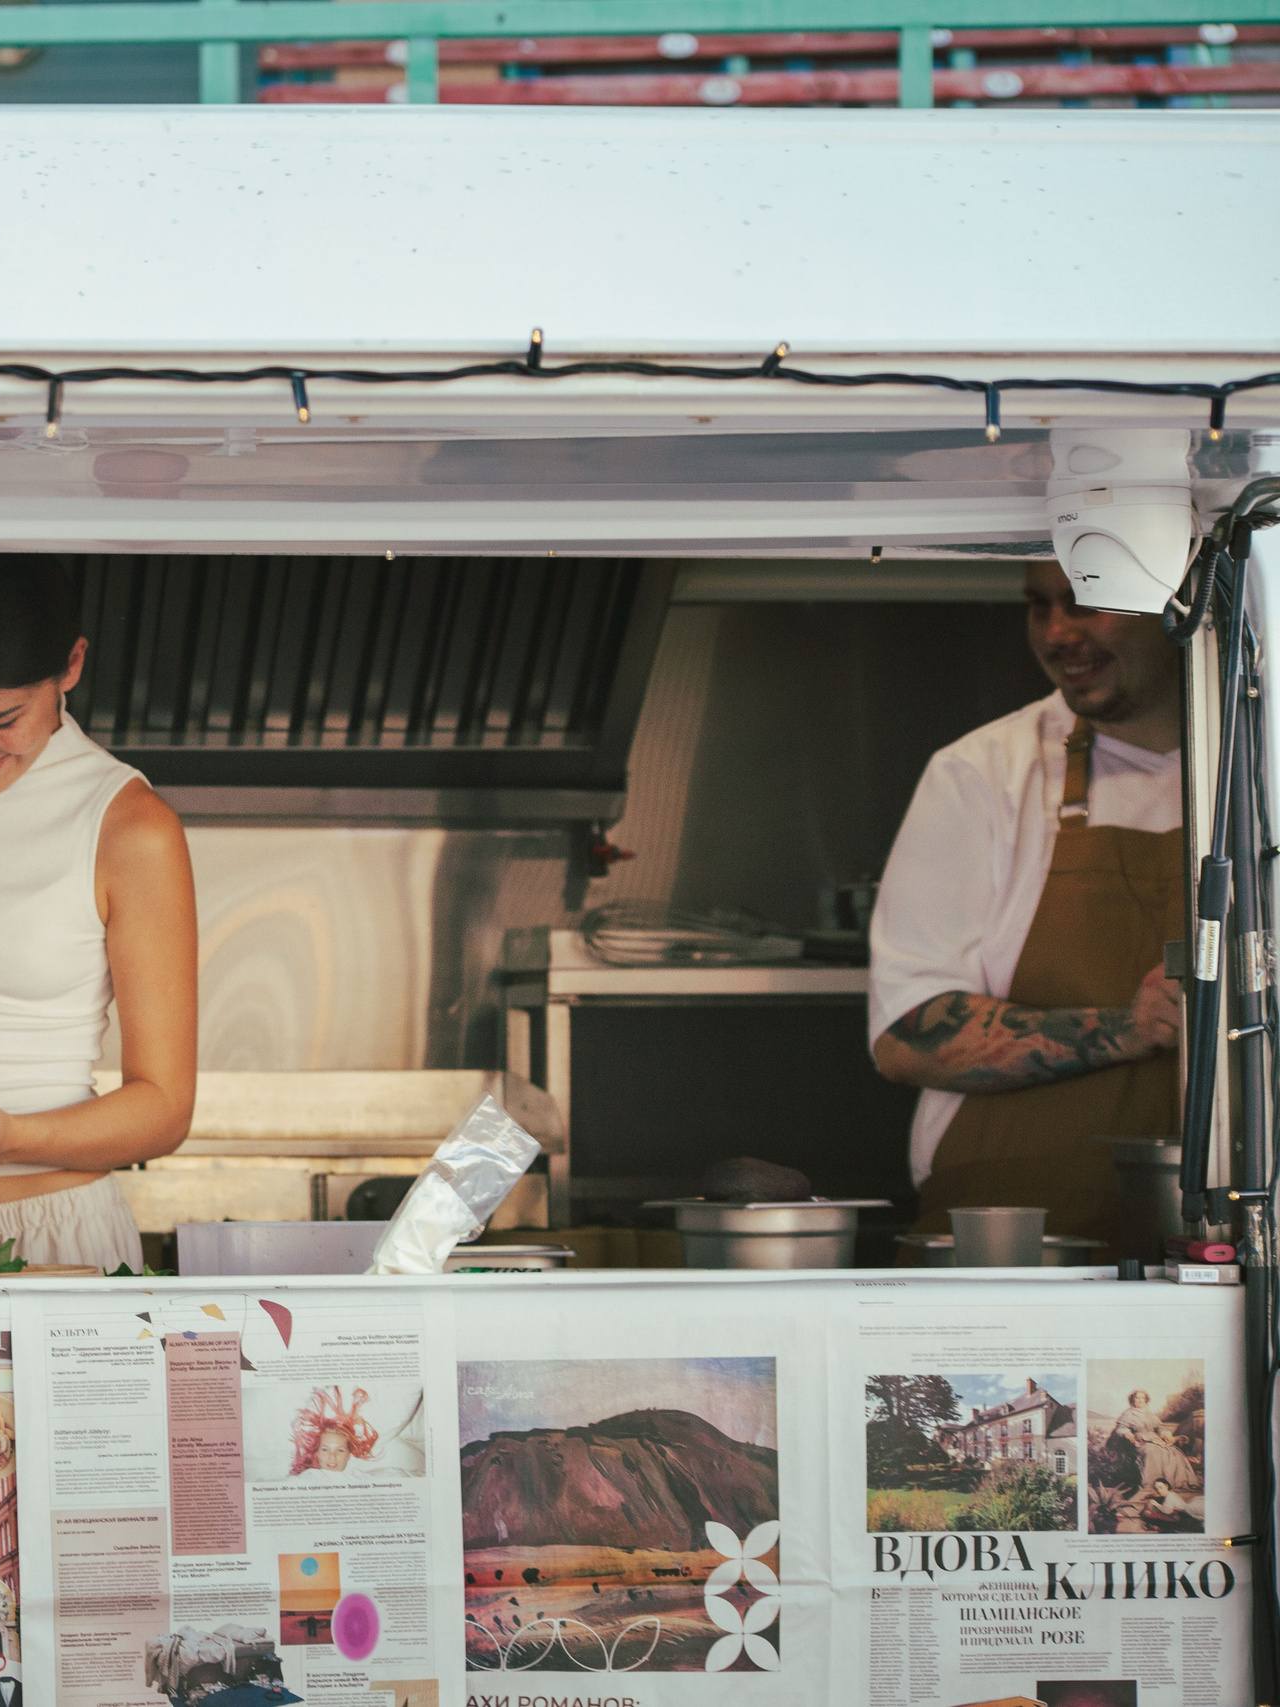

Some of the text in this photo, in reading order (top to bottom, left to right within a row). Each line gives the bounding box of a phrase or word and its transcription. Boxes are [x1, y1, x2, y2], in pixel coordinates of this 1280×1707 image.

[50, 1328, 99, 1338] КУЛЬТУРА
[872, 1534, 1035, 1582] ВДОВА
[1044, 1559, 1236, 1600] КЛИКО
[978, 1582, 1040, 1592] ЖЕНЩИНА,
[941, 1592, 1039, 1603] КОТОРАЯ СДЕЛАЛА
[959, 1606, 1082, 1621] ШАМПАНСКОЕ
[959, 1625, 1033, 1635] ПРОЗРАЧНЫМ
[959, 1636, 1034, 1647] И ПРИДУМАЛА
[1040, 1630, 1085, 1645] РОЗЕ
